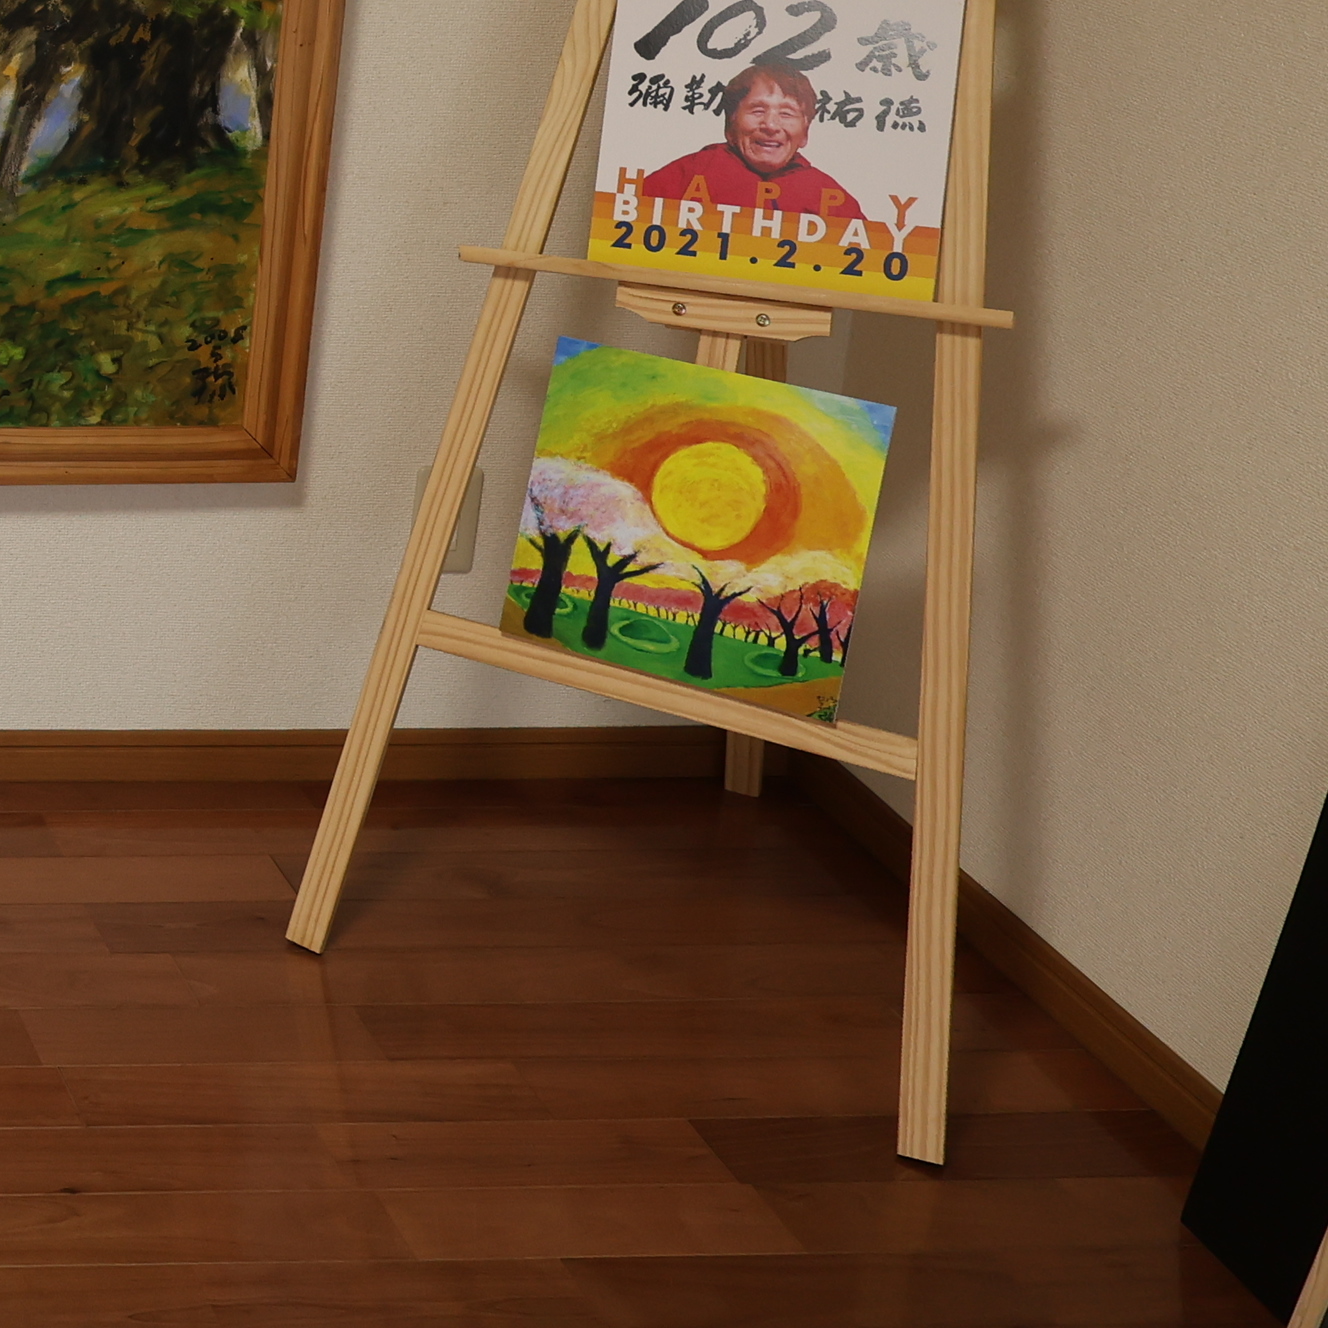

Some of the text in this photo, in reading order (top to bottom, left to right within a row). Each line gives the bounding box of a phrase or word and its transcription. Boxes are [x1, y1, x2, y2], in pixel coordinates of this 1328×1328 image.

[613, 192, 916, 254] BIRTHDAY
[616, 166, 918, 227] HAPPY
[611, 221, 909, 281] 2021.2.20
